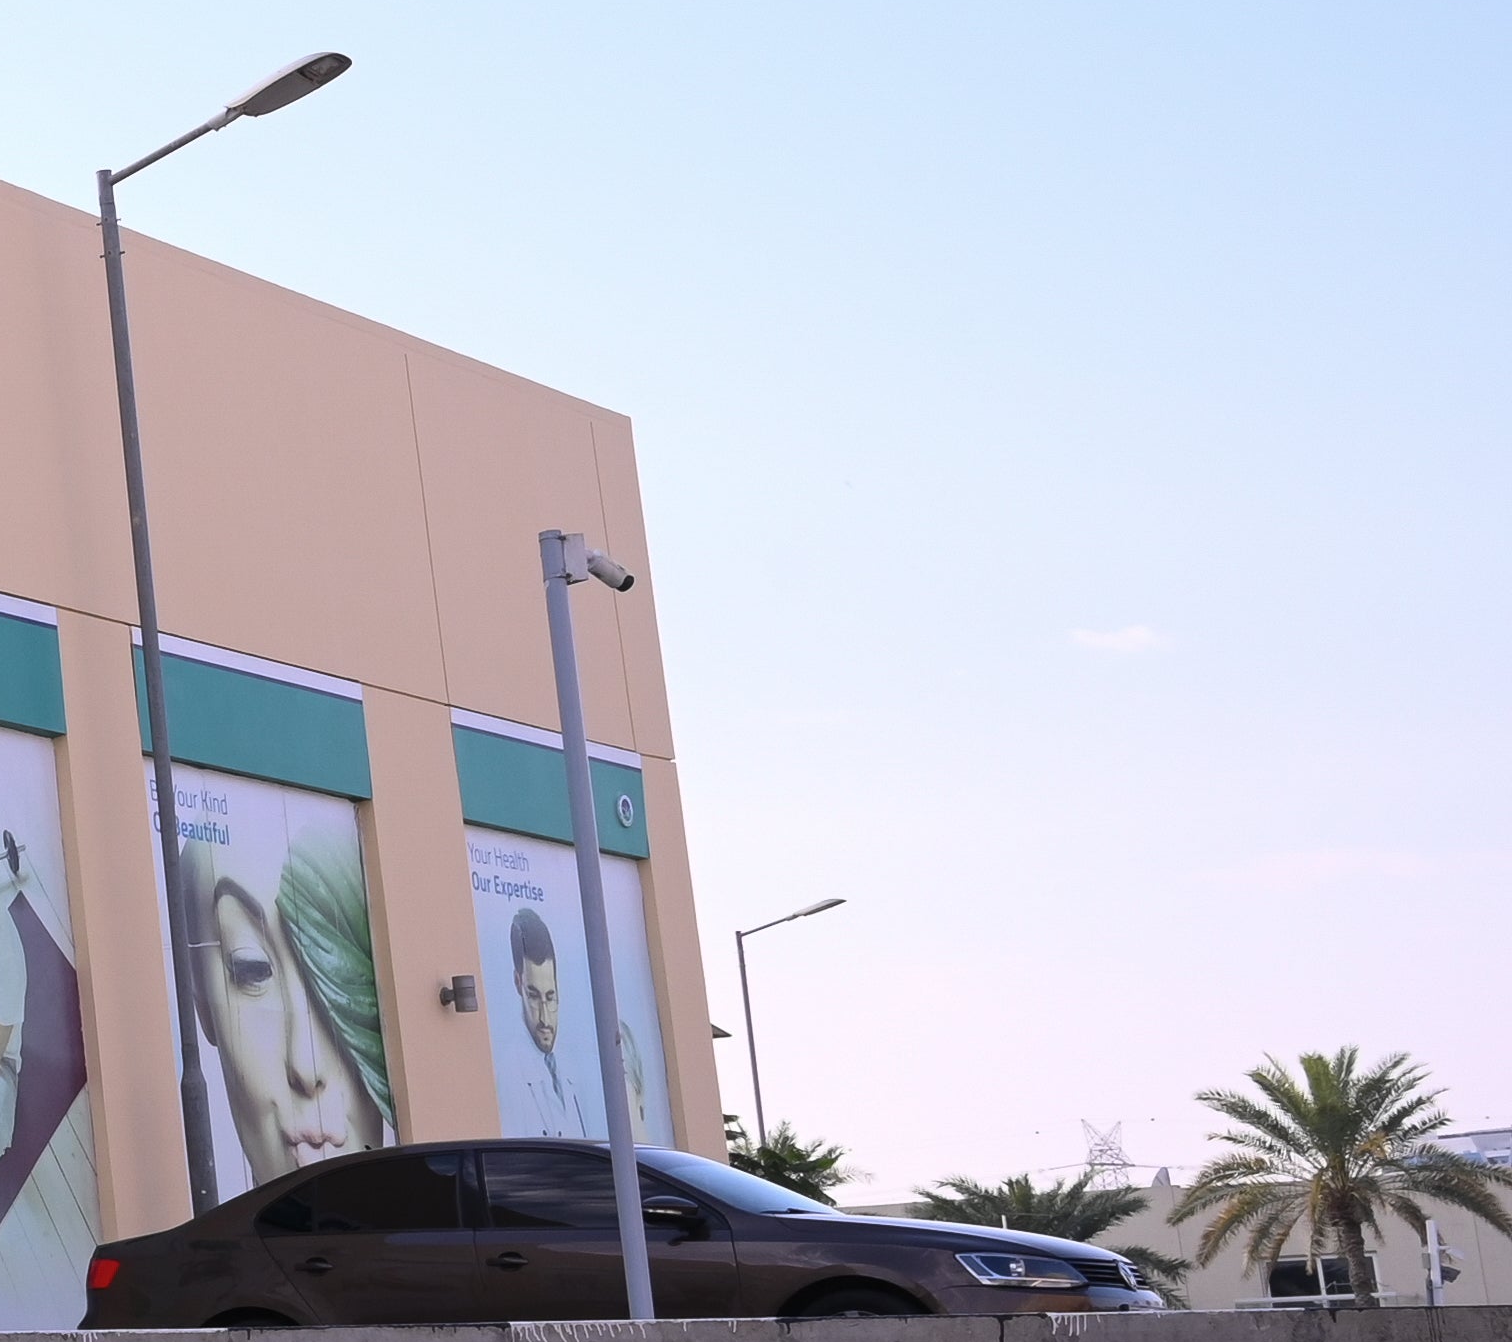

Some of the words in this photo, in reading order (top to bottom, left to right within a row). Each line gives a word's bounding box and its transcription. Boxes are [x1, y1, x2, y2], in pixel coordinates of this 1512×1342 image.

[150, 779, 158, 801] B
[200, 789, 228, 815] Kind
[467, 842, 491, 865] Your
[493, 847, 530, 872] Health
[471, 870, 491, 893] Our
[493, 875, 544, 902] Expertise
